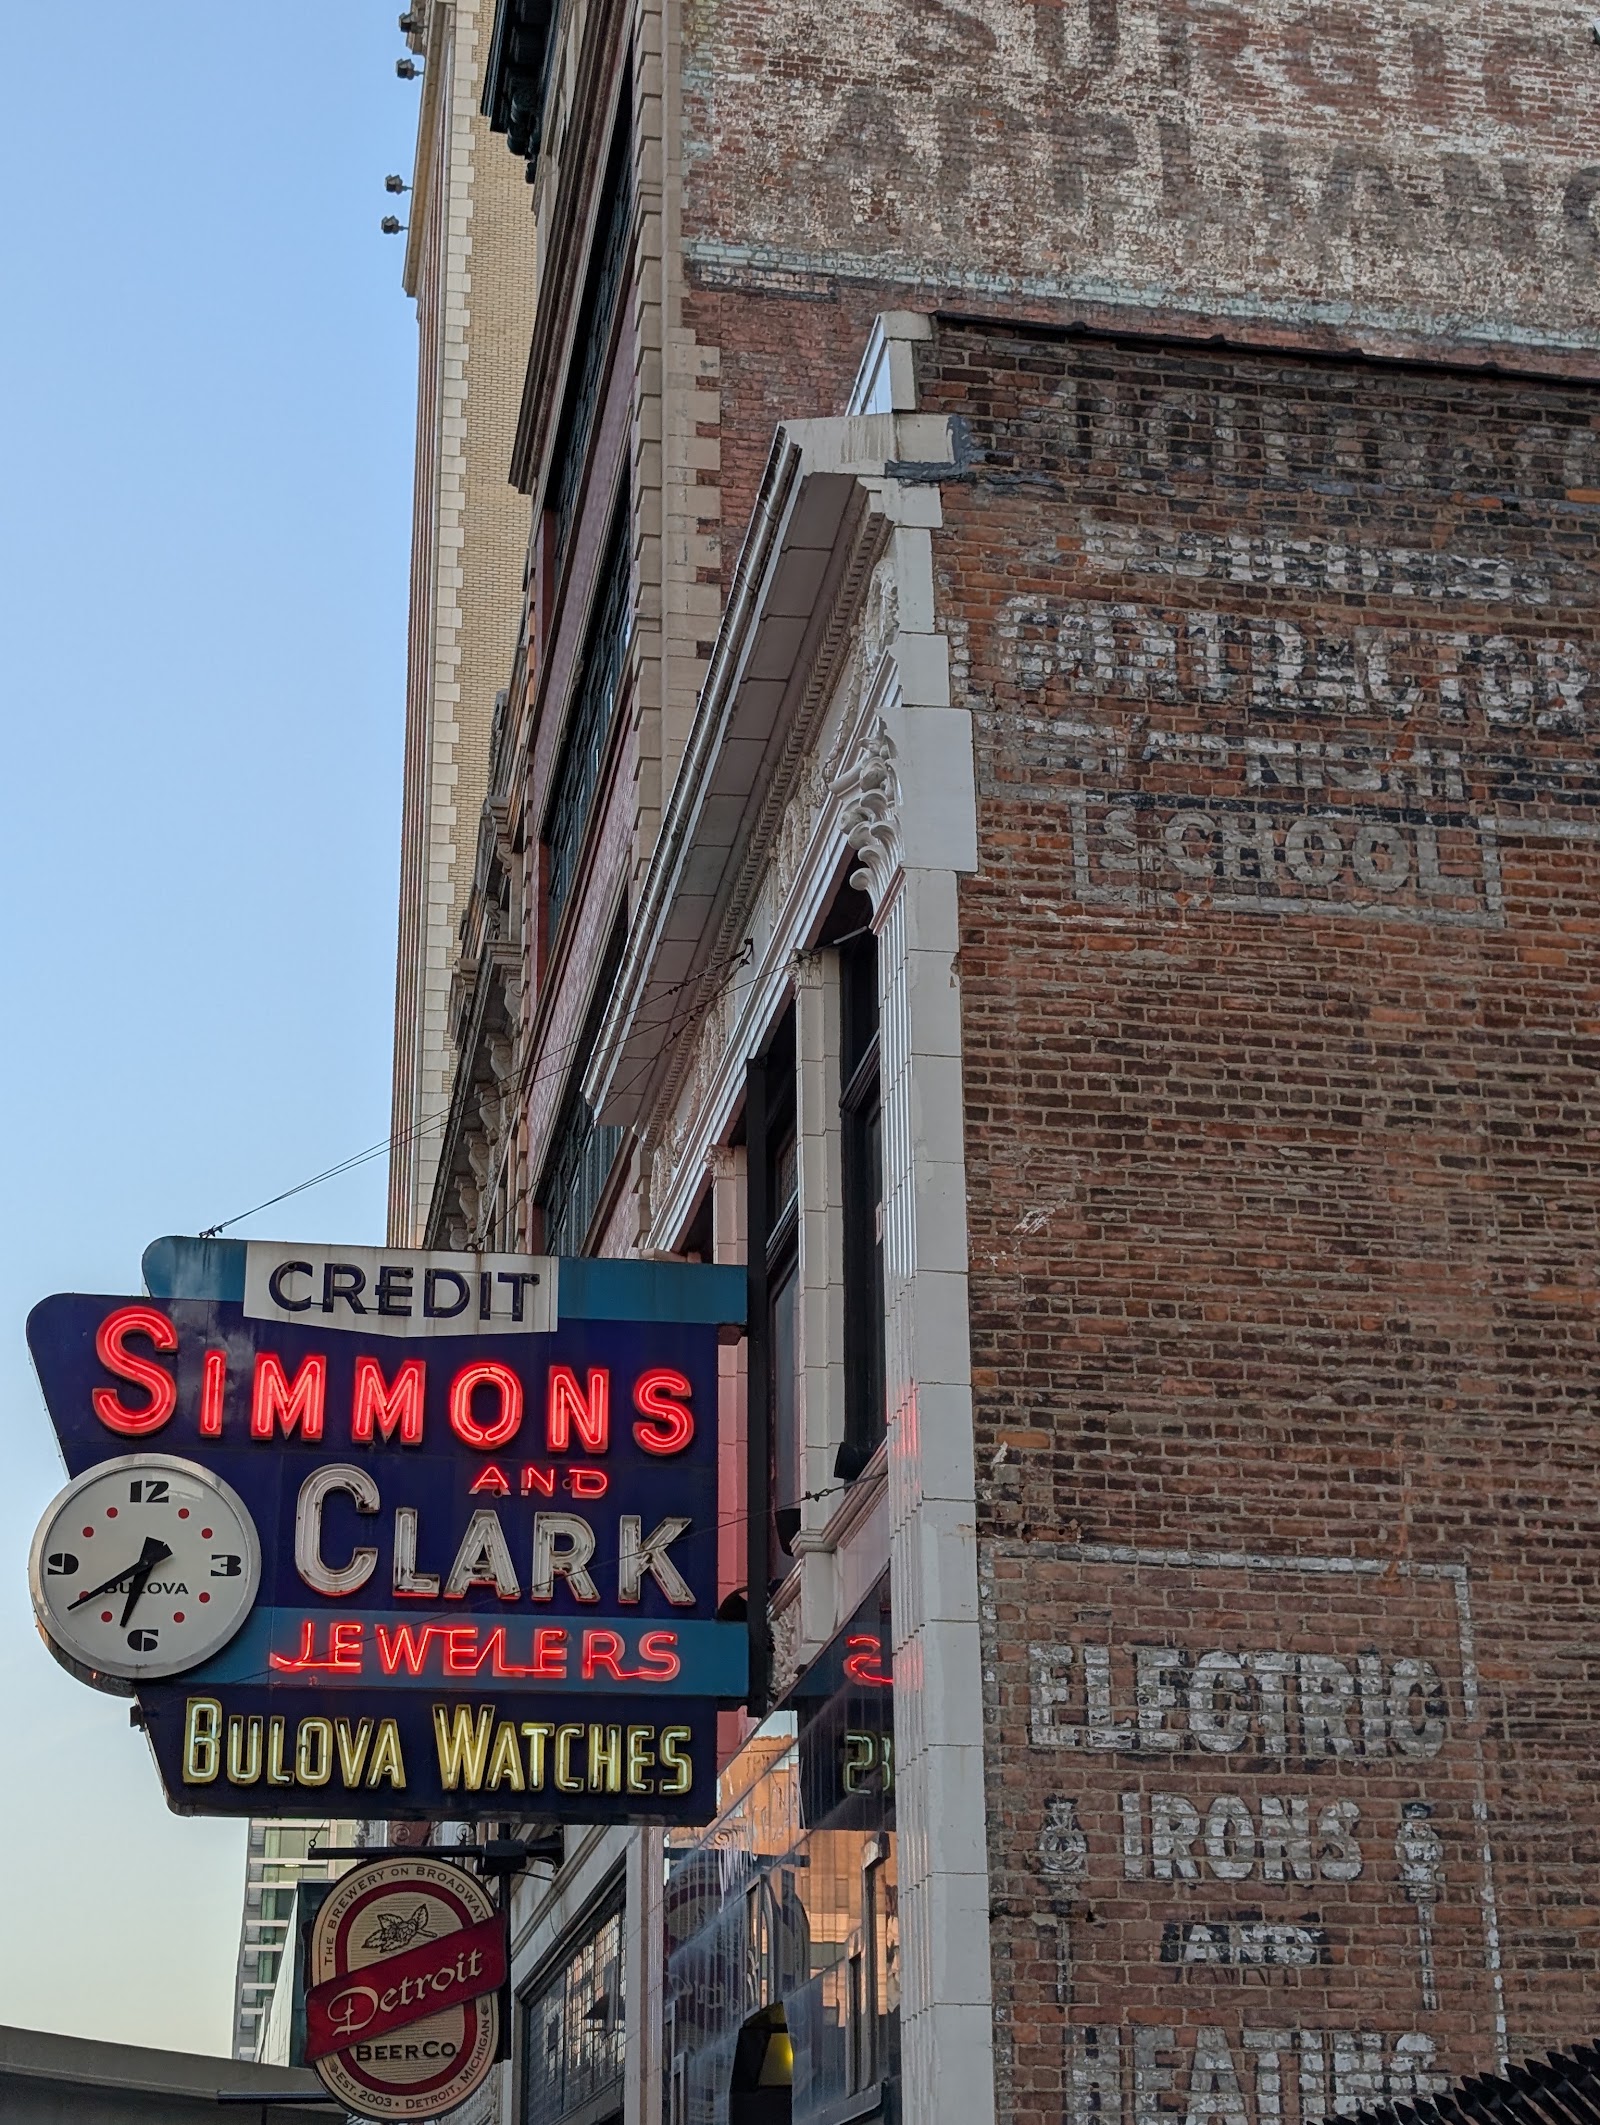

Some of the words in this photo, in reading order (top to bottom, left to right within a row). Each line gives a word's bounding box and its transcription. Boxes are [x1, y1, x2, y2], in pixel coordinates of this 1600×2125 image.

[1098, 805, 1480, 895] SCHOOL
[268, 1260, 540, 1322] CREDIT
[92, 1306, 695, 1455] SIMMONS
[129, 1479, 170, 1504] 12
[468, 1465, 609, 1499] AND
[47, 1552, 80, 1576] 9
[294, 1462, 696, 1606] CLARK
[104, 1581, 190, 1596] BUOVA
[210, 1554, 243, 1578] 3
[126, 1628, 160, 1653] 6
[270, 1621, 681, 1682] JEWELERS
[1028, 1644, 1447, 1760] ELECTRIC
[182, 1698, 406, 1789] BULOVA
[432, 1704, 693, 1794] WATCHES
[1117, 1792, 1364, 1882] IRONS
[327, 1870, 385, 1930] BREWERY
[391, 1867, 409, 1877] ON
[416, 1866, 486, 1920] BROADWAY
[324, 1936, 335, 1966] THE
[1183, 1923, 1318, 1964] AND
[327, 1947, 483, 2037] Detroit
[358, 2089, 393, 2108] 2003
[459, 2019, 491, 2085] MICHIGAN
